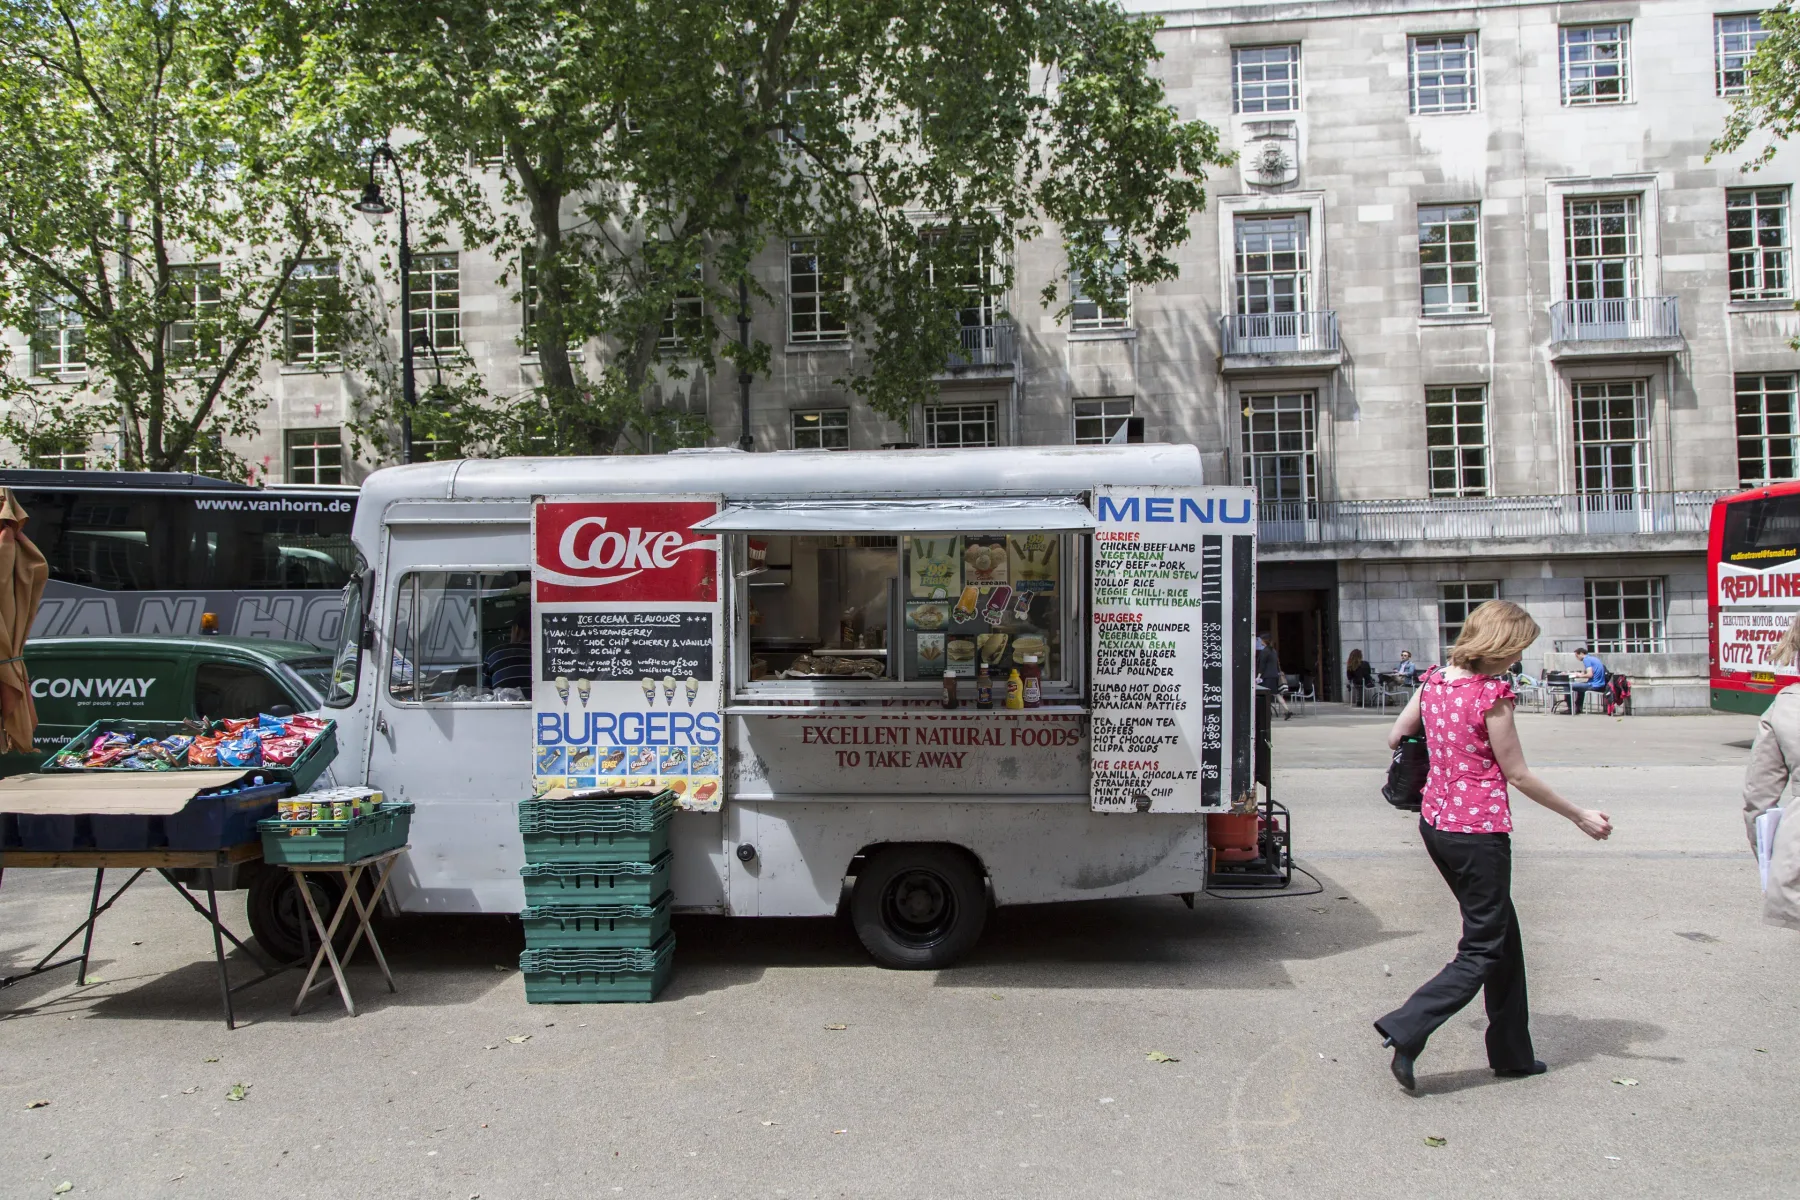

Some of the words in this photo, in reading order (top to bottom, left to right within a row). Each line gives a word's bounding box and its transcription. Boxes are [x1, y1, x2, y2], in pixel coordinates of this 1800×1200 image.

[195, 499, 351, 512] www.vanhorn.de
[1098, 496, 1251, 524] MENU
[1095, 532, 1140, 541] CURRIES
[558, 516, 683, 569] Coke
[1100, 542, 1140, 551] CHICKEN
[1143, 543, 1167, 551] BEEF
[1168, 543, 1196, 553] LAMB
[1100, 551, 1164, 560] VEGETARIAN
[1094, 560, 1122, 570] SPICY
[1125, 561, 1150, 569] BEEF
[1159, 561, 1186, 570] PORK
[1122, 570, 1170, 579] PLANTAIN
[1172, 571, 1199, 579] STEW
[1094, 578, 1129, 587] JOLLOF
[1133, 579, 1155, 587] RICE
[1094, 587, 1128, 596] VEGGIE
[1131, 588, 1162, 597] CHILLI
[1167, 589, 1188, 597] RICE
[1721, 573, 1800, 604] REDLINE
[1096, 597, 1131, 606] KUTTU
[1135, 598, 1169, 607] KUTTU
[1171, 598, 1201, 607] BEANS
[577, 615, 593, 624] ICE
[595, 614, 630, 624] CREAM
[633, 614, 681, 623] FLAVOURS
[1094, 613, 1143, 624] BURGERS
[1752, 616, 1773, 627] MOTOR
[1775, 616, 1796, 627] COAC
[1099, 623, 1143, 632] QUARTER
[1147, 623, 1190, 632] POUNDER
[1098, 631, 1158, 640] VEGEBURGER
[1736, 629, 1787, 642] PRESTON
[1099, 641, 1144, 649] MEXICAN
[1149, 641, 1176, 649] BEAN
[1097, 650, 1136, 658] CHICKEN
[1140, 650, 1176, 658] BURGER
[1722, 642, 1753, 665] 01772
[1097, 658, 1117, 666] EGG
[1120, 659, 1157, 667] BURGER
[1096, 667, 1122, 675] HALF
[1126, 667, 1174, 676] POUNDER
[31, 678, 156, 698] CONWAY
[1092, 684, 1127, 692] JUMBO
[1129, 684, 1149, 692] HOT
[1152, 684, 1181, 692] DOGS
[1093, 693, 1111, 701] EGG
[1120, 693, 1152, 701] BACON
[1092, 701, 1142, 710] JAMAICAN
[1146, 702, 1187, 710] PATTIES
[1120, 718, 1152, 726] LEMON
[1156, 718, 1176, 727] TEA
[537, 712, 721, 745] BURGERS
[1093, 726, 1134, 735] COFFEES
[34, 735, 76, 744] www.fm
[802, 726, 910, 744] EXCELLENT
[915, 726, 1006, 746] NATURAL
[1010, 727, 1079, 746] FOODS
[1093, 735, 1115, 744] HOT
[1119, 736, 1179, 744] CHOCOLATE
[1093, 744, 1124, 752] CUPPA
[1127, 744, 1158, 753] SOUPS
[836, 750, 860, 767] TO
[864, 750, 912, 768] TAKE
[916, 751, 968, 768] AWAY
[1094, 761, 1109, 770] ICE
[1094, 779, 1152, 787] STRAWBERRY
[1095, 788, 1119, 796] MINT
[1151, 788, 1173, 796] CHIP
[1093, 796, 1126, 805] LEMON
